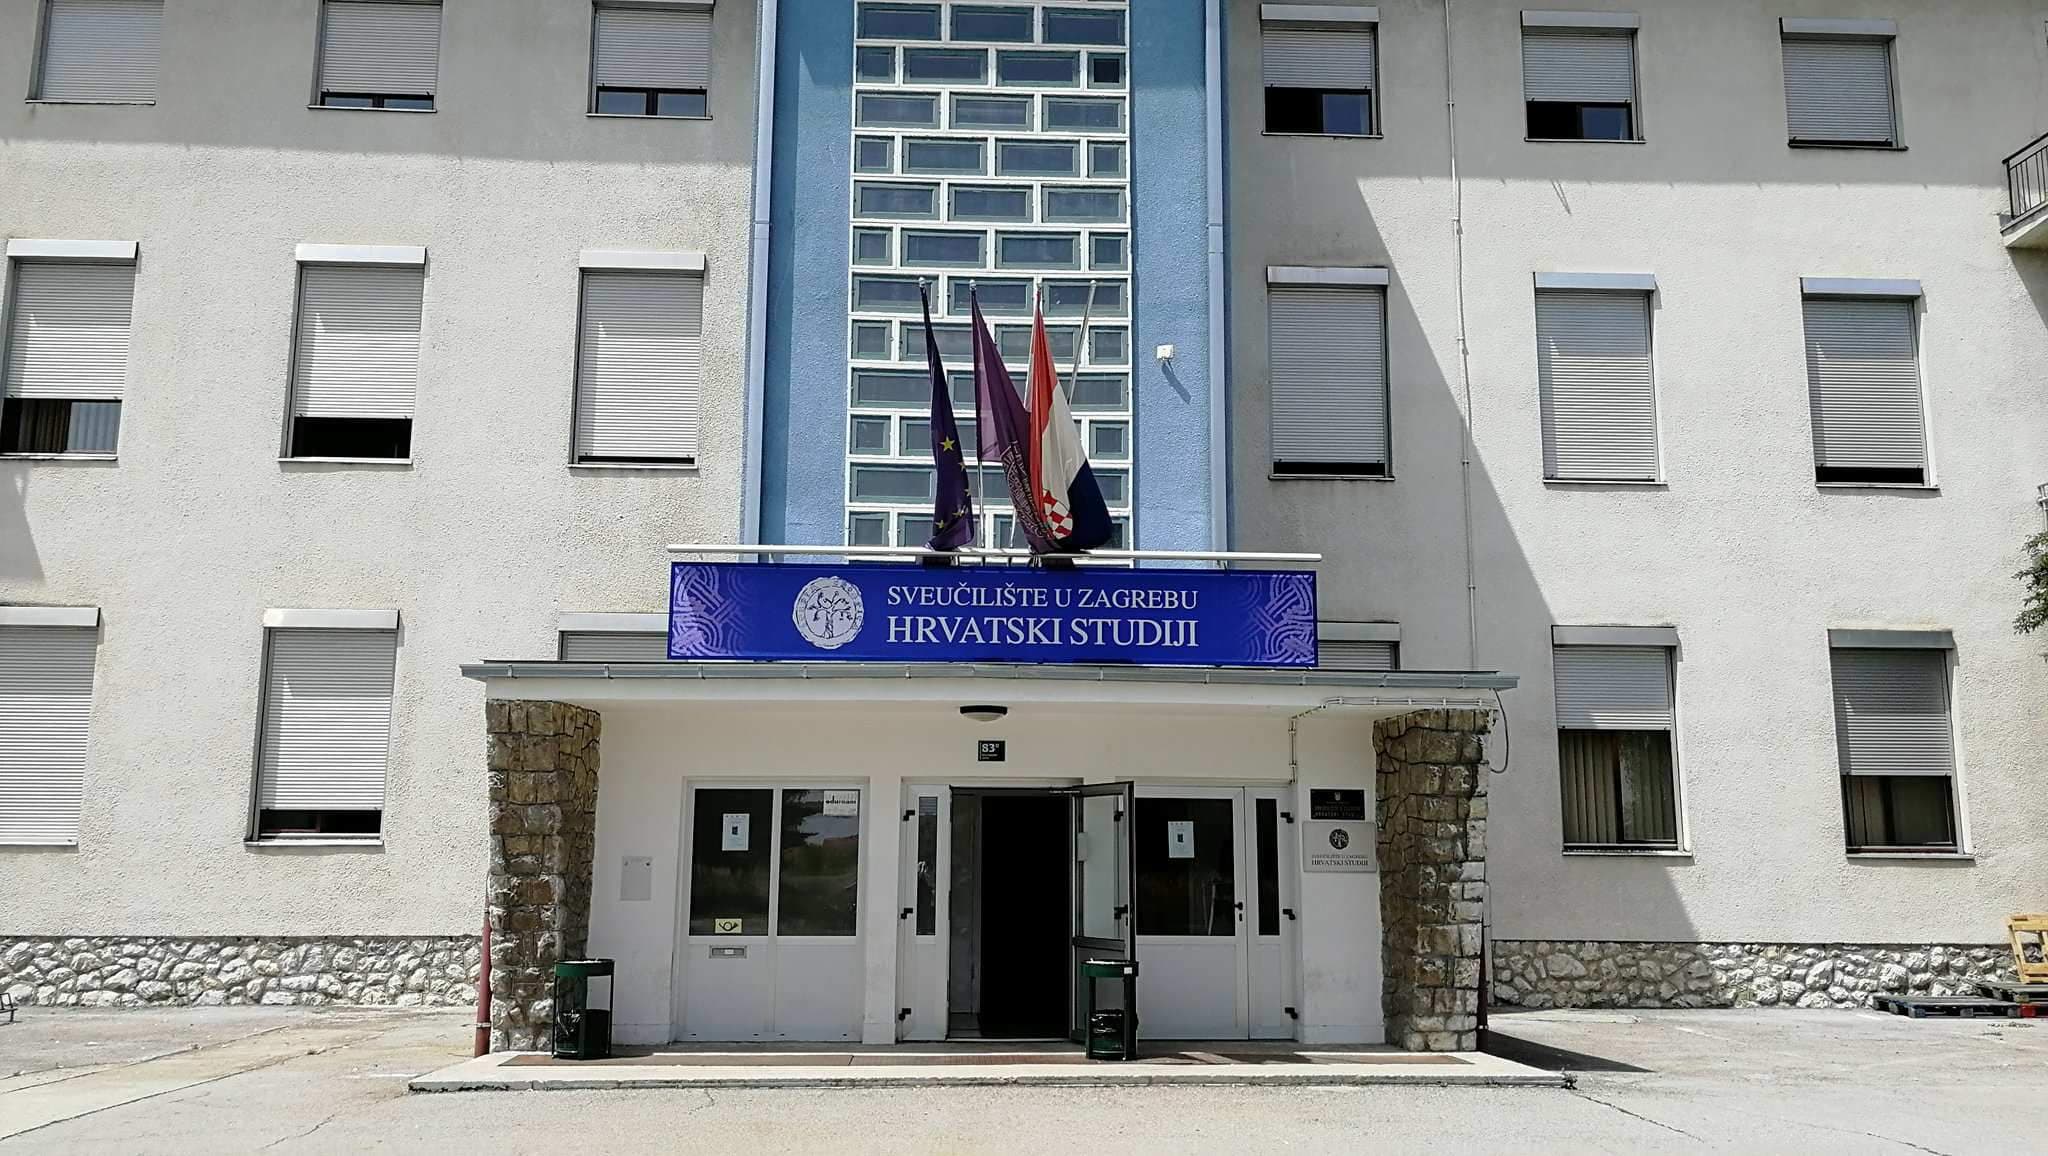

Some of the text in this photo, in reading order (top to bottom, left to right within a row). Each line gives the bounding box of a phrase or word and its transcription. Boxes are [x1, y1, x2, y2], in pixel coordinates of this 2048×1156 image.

[887, 582, 1199, 609] SVEUČILIŠTE U ZAGREBU
[886, 615, 1200, 646] HRVATSKI STUDIJI
